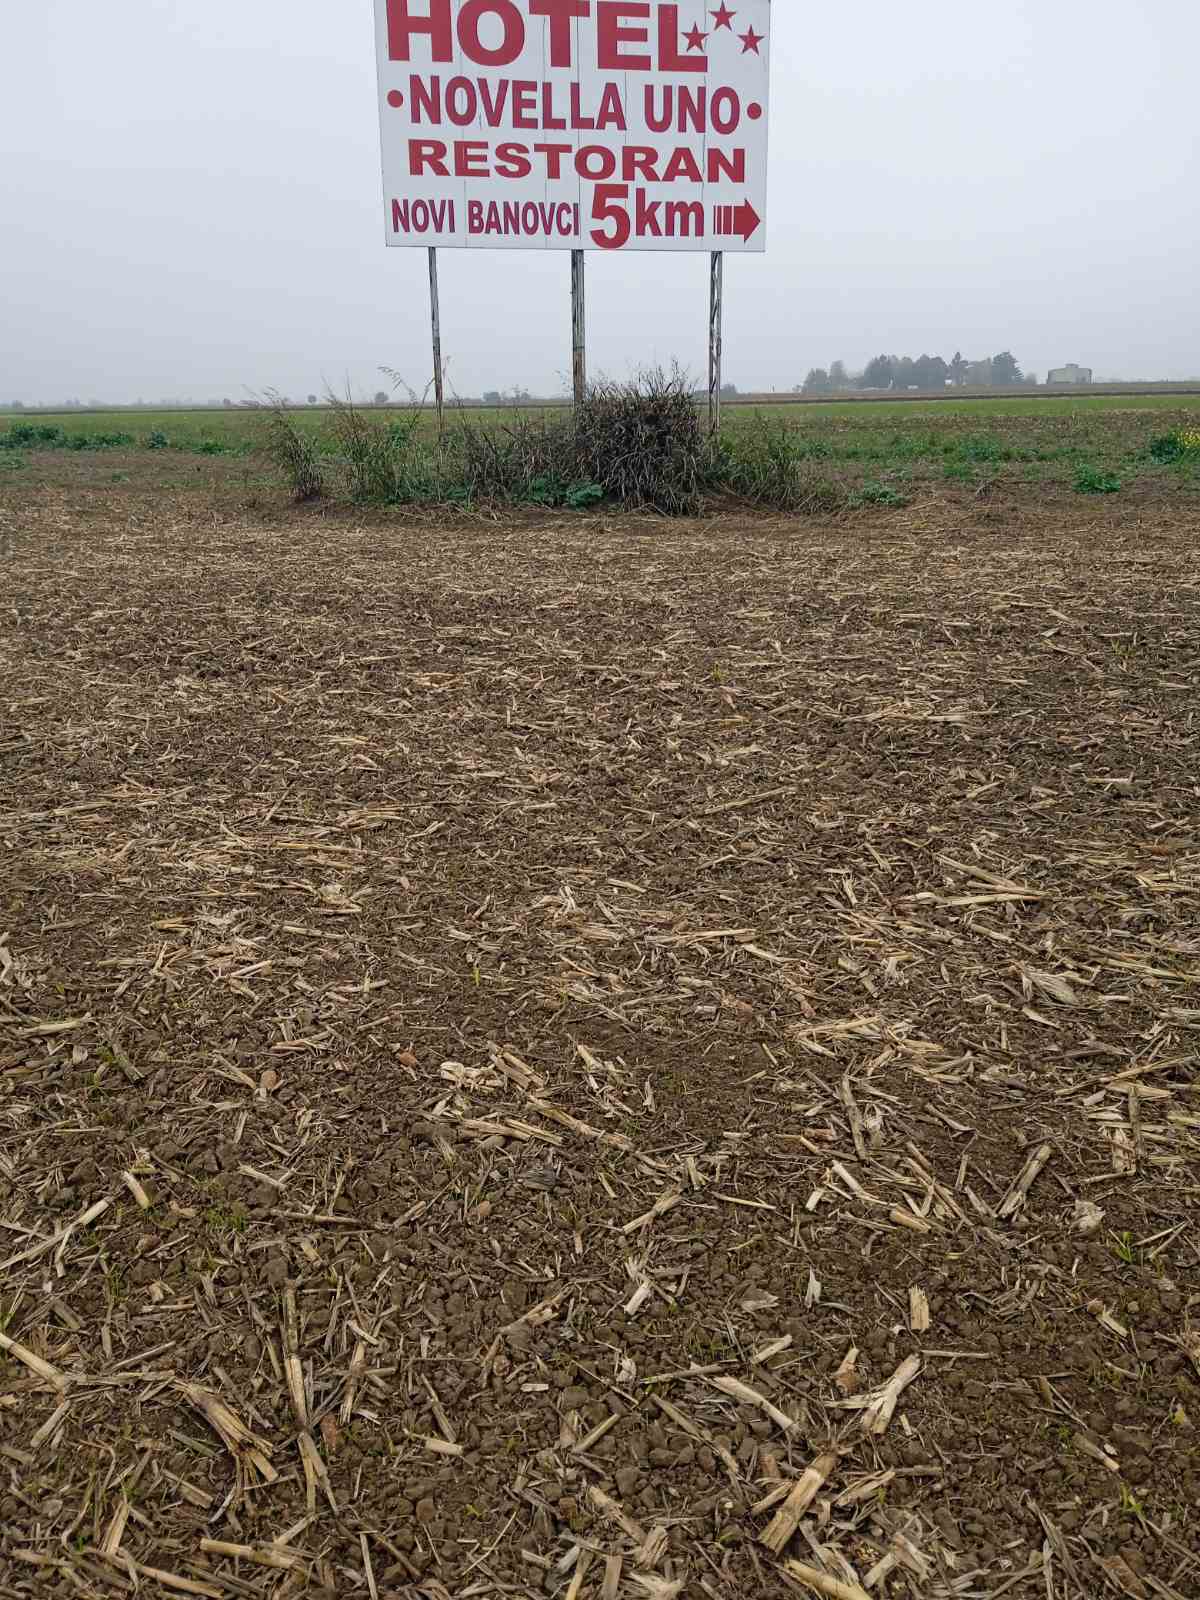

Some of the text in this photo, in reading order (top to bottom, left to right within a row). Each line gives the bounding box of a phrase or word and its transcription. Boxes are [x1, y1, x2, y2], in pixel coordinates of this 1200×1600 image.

[386, 0, 709, 73] HOTEL
[408, 74, 741, 135] NOVELLA UNO
[408, 139, 746, 184] RESTORAN
[391, 183, 705, 251] NOVI BANOVCI 5km
